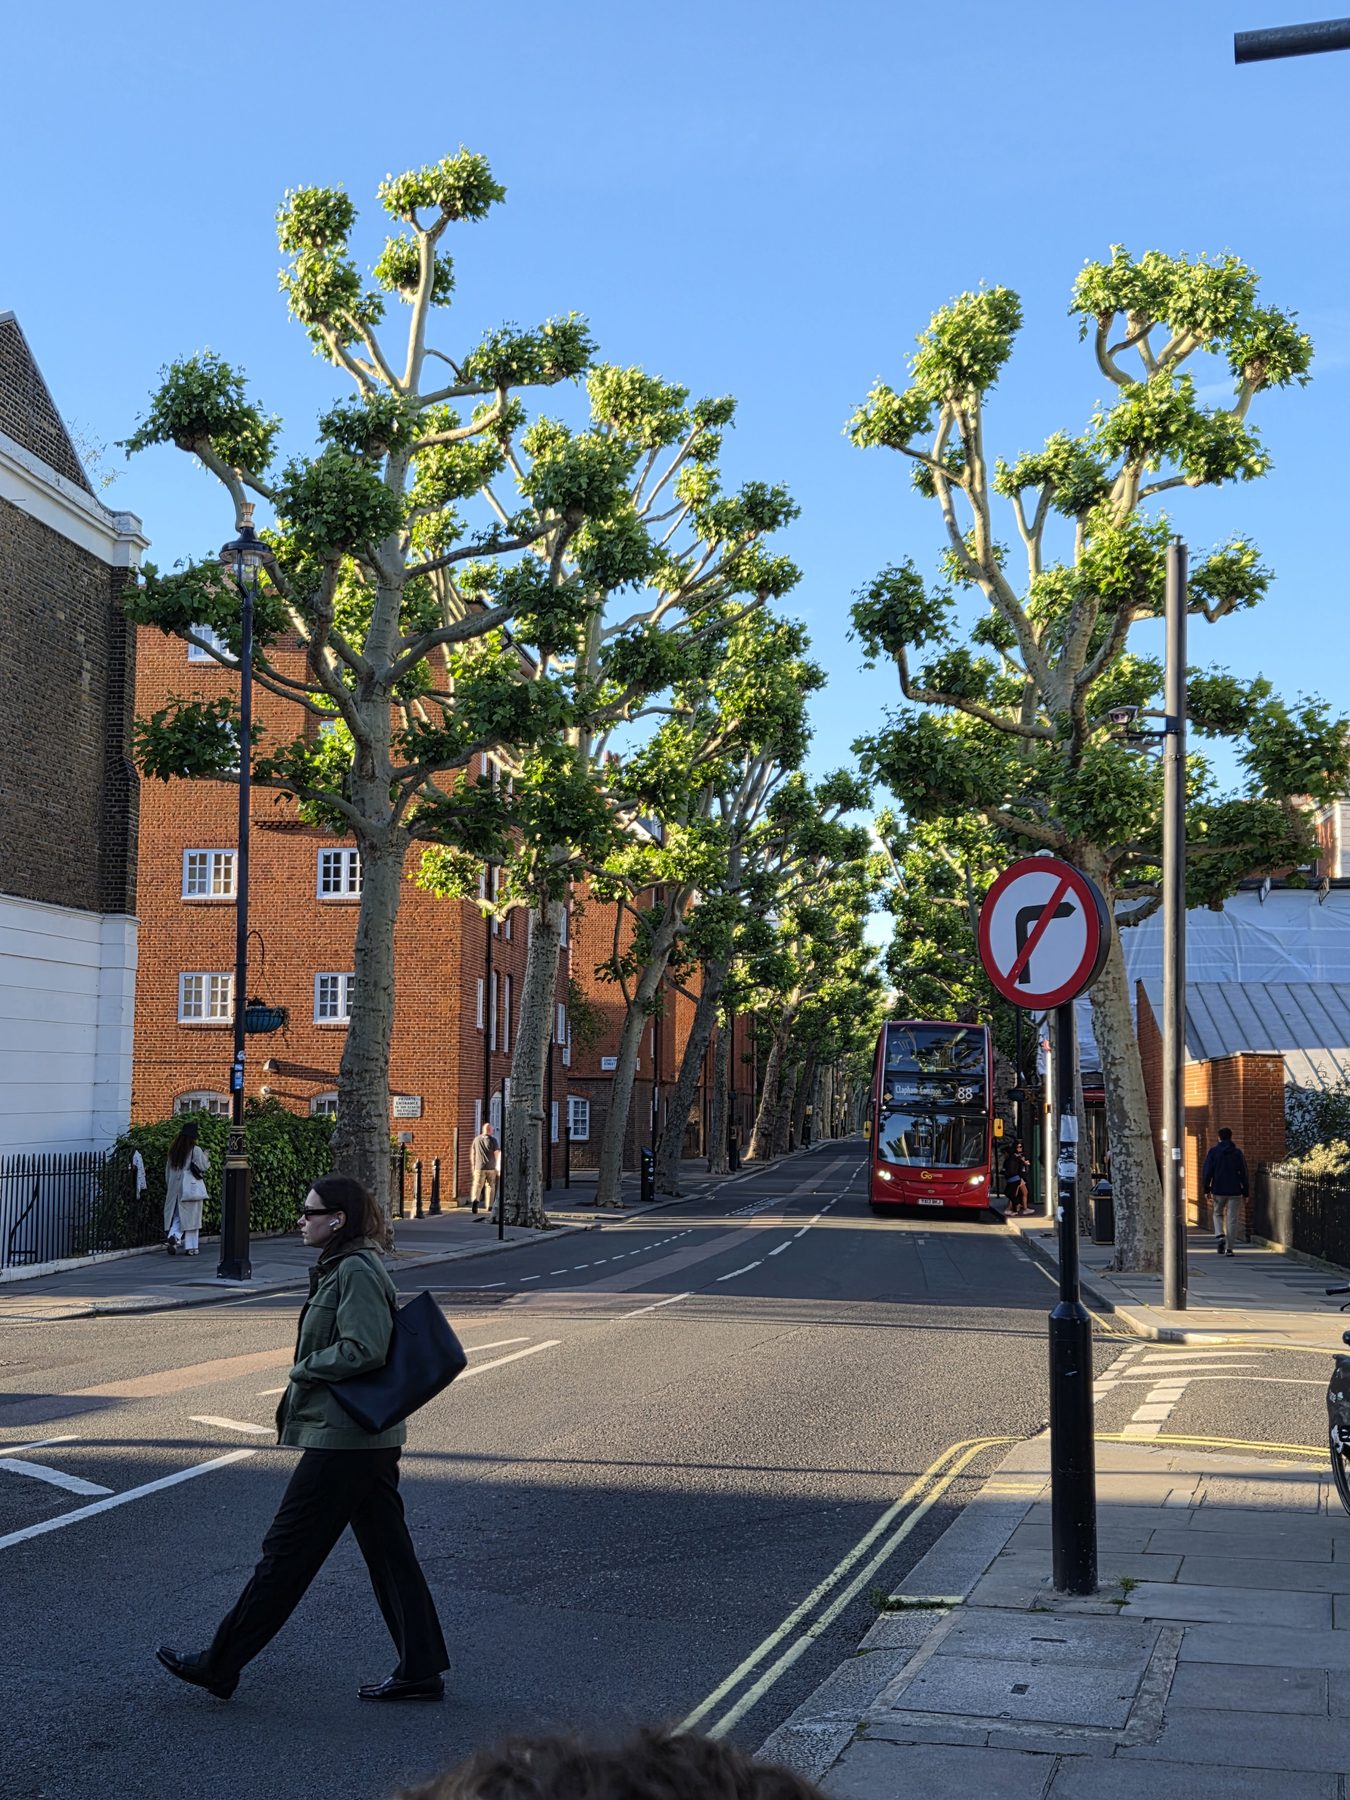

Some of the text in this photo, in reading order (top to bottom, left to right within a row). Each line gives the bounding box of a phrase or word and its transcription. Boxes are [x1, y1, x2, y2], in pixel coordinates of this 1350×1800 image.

[895, 1085, 918, 1096] Clapham
[957, 1087, 973, 1100] 88
[920, 1170, 932, 1180] Go
